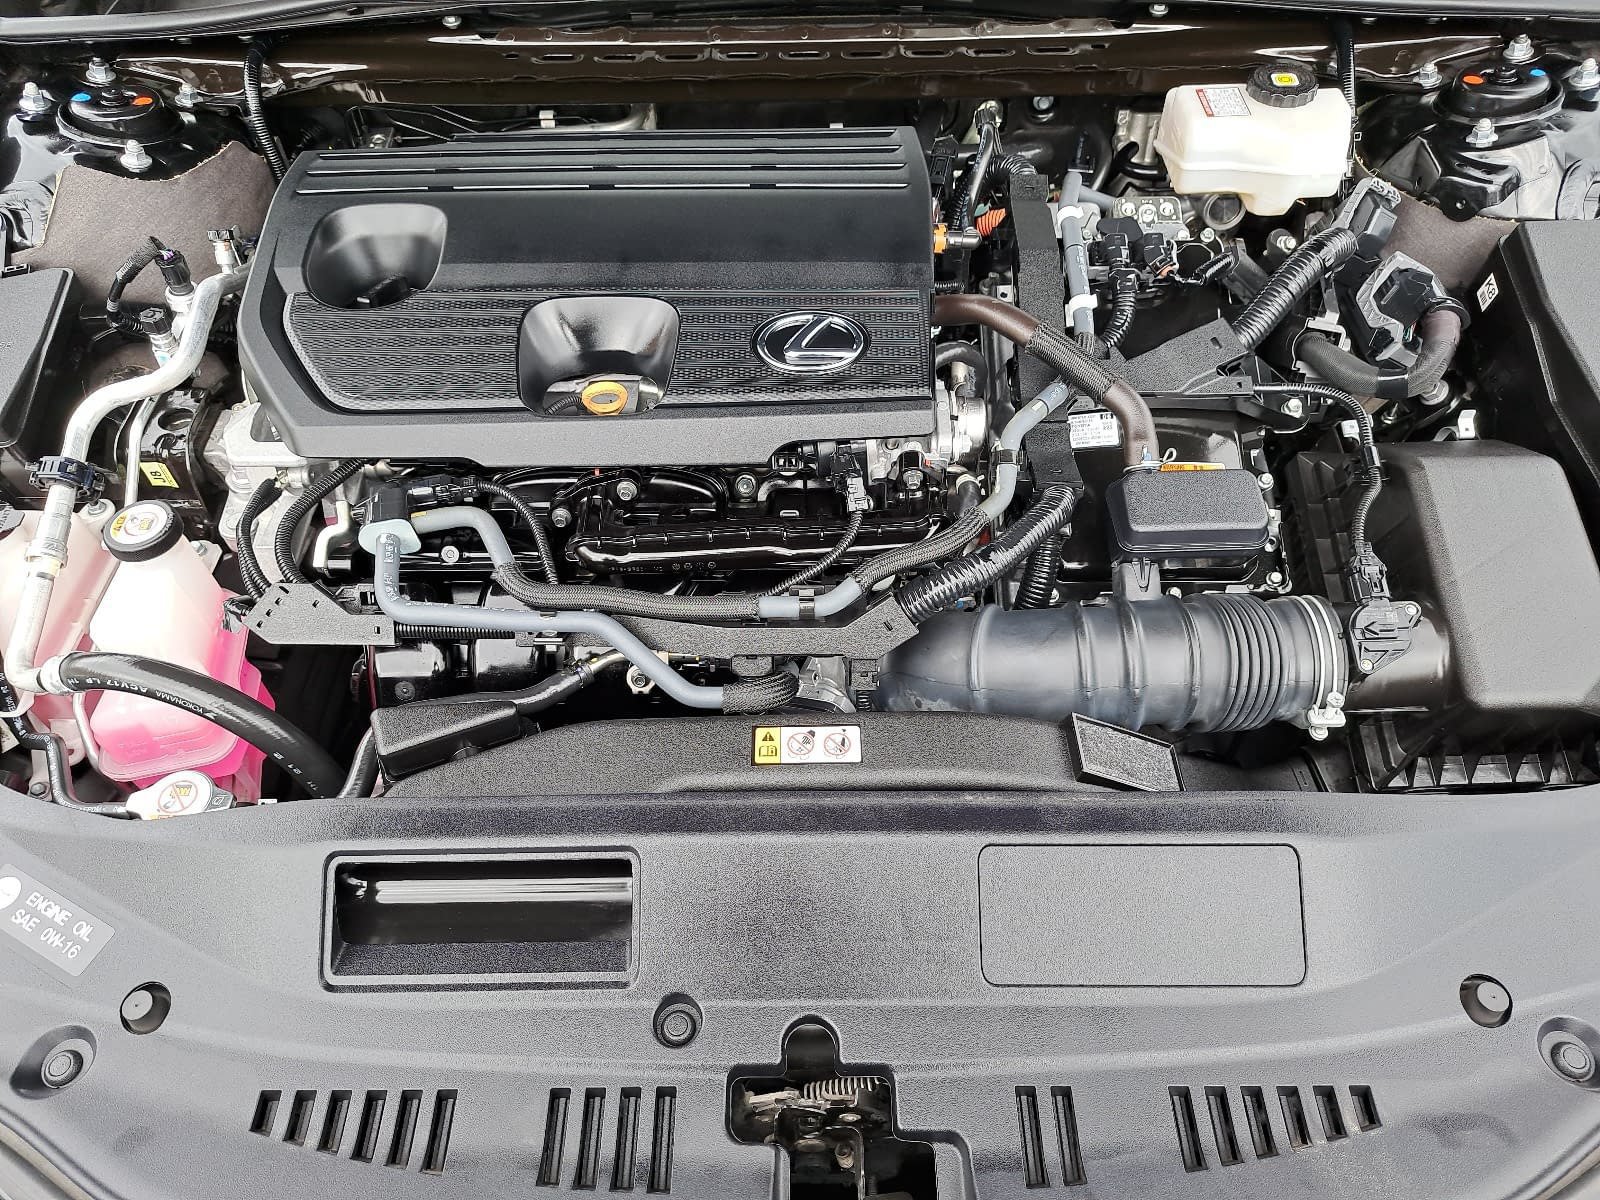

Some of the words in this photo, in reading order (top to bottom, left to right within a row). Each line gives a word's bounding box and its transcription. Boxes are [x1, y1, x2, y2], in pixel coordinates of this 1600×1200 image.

[1485, 278, 1496, 300] K8
[150, 471, 166, 483] J8
[107, 679, 148, 693] ACV17
[155, 689, 203, 715] YOKOHAMA
[11, 909, 41, 933] SAE
[26, 891, 73, 927] ENGINE
[72, 920, 94, 942] OIL
